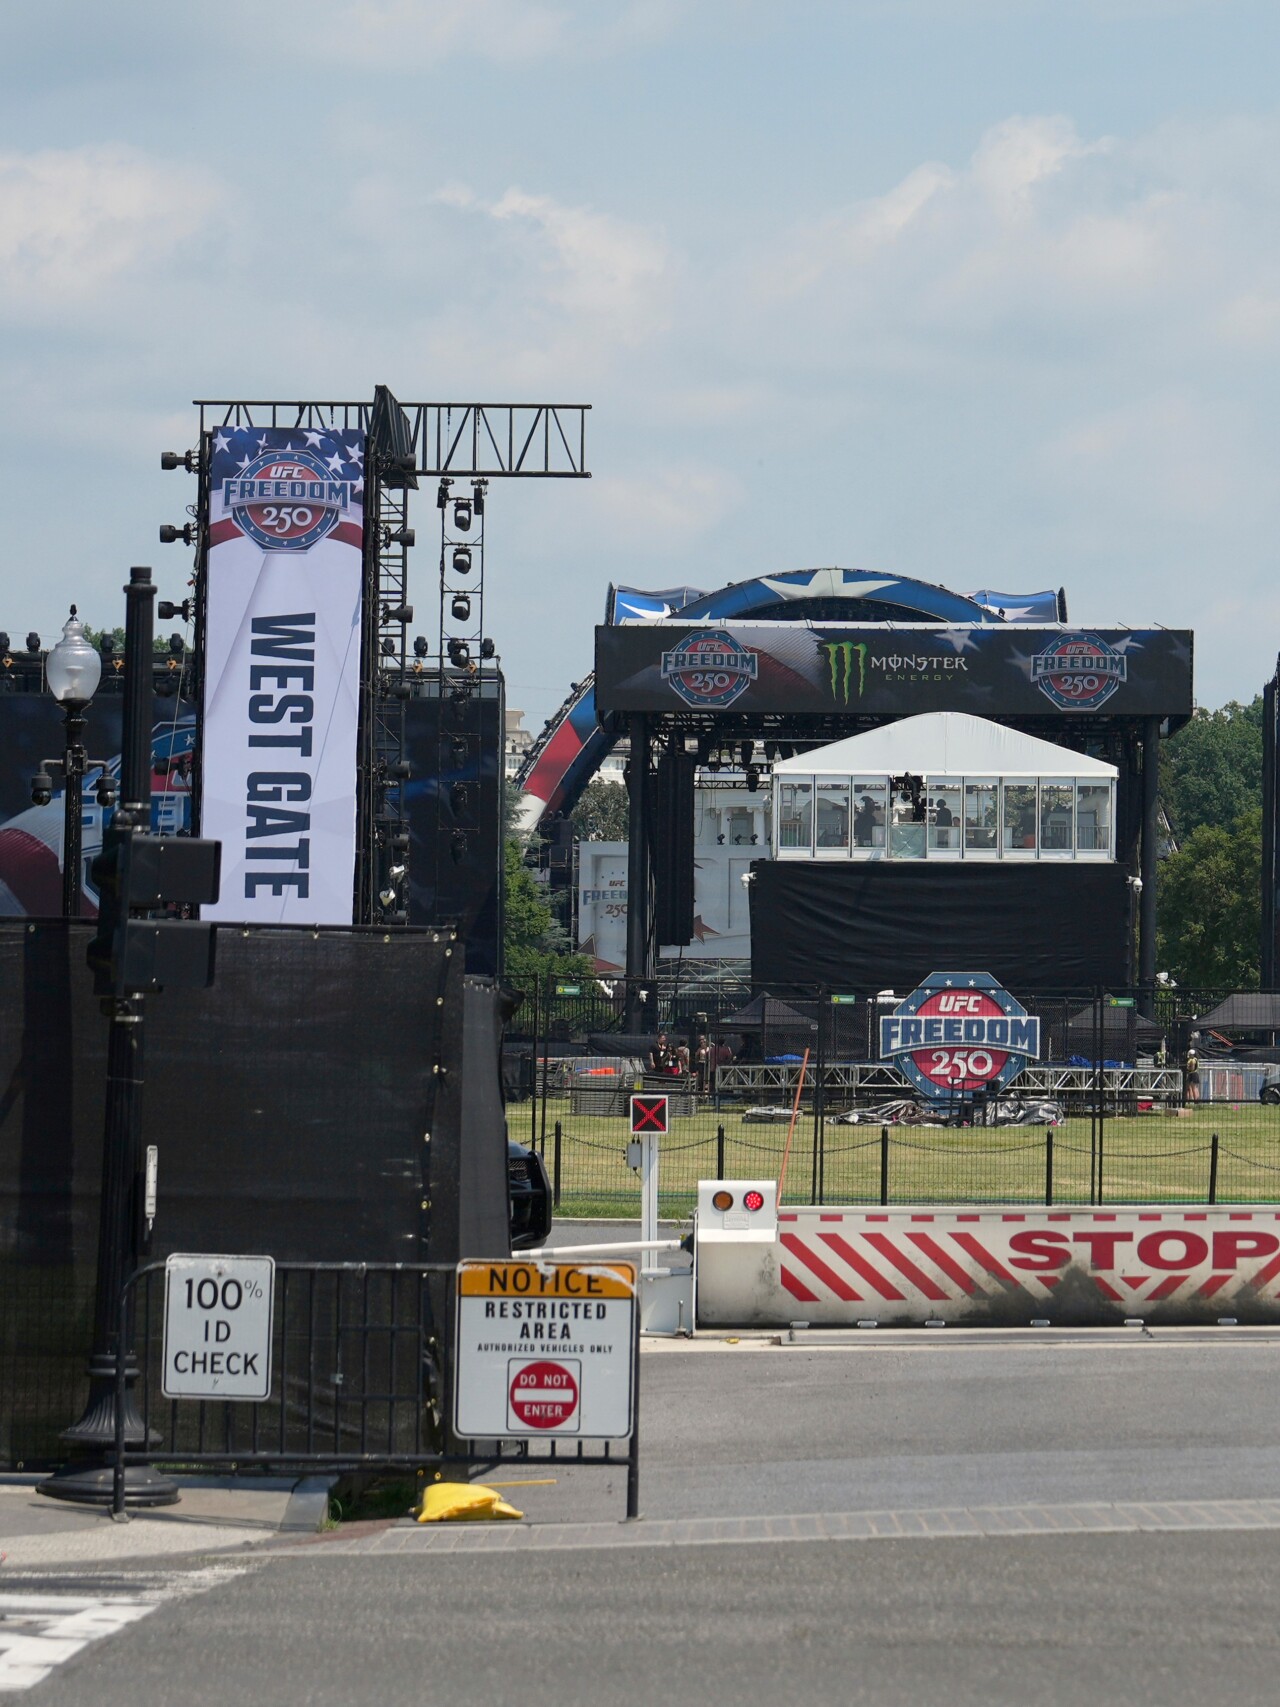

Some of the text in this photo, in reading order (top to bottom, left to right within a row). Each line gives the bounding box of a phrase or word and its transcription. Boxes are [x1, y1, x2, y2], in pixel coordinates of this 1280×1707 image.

[269, 466, 304, 478] UFC
[224, 480, 348, 509] FREEDOM
[260, 506, 313, 534] 250
[696, 642, 723, 652] UFC
[1066, 645, 1092, 655] UFC
[662, 653, 756, 674] FREEDOM
[870, 653, 969, 672] MONSTER
[1032, 656, 1125, 677] FREEDOM
[690, 672, 729, 693] 250
[1060, 675, 1098, 696] 250
[244, 612, 316, 899] WEST GATE
[583, 890, 628, 906] FREED
[938, 995, 982, 1013] UFC
[882, 1018, 1038, 1055] FREEDOM
[929, 1050, 993, 1085] 250
[1007, 1230, 1280, 1271] STOP
[489, 1268, 604, 1294] NOTICE
[485, 1301, 607, 1320] RESTRICTED
[204, 1320, 231, 1343] ID
[519, 1322, 572, 1340] AREA
[477, 1343, 613, 1354] AUTHORIZED VEHICLES ONLY
[173, 1350, 259, 1376] CHECK
[519, 1374, 569, 1387] DO NOT
[524, 1404, 564, 1417] ENTER
